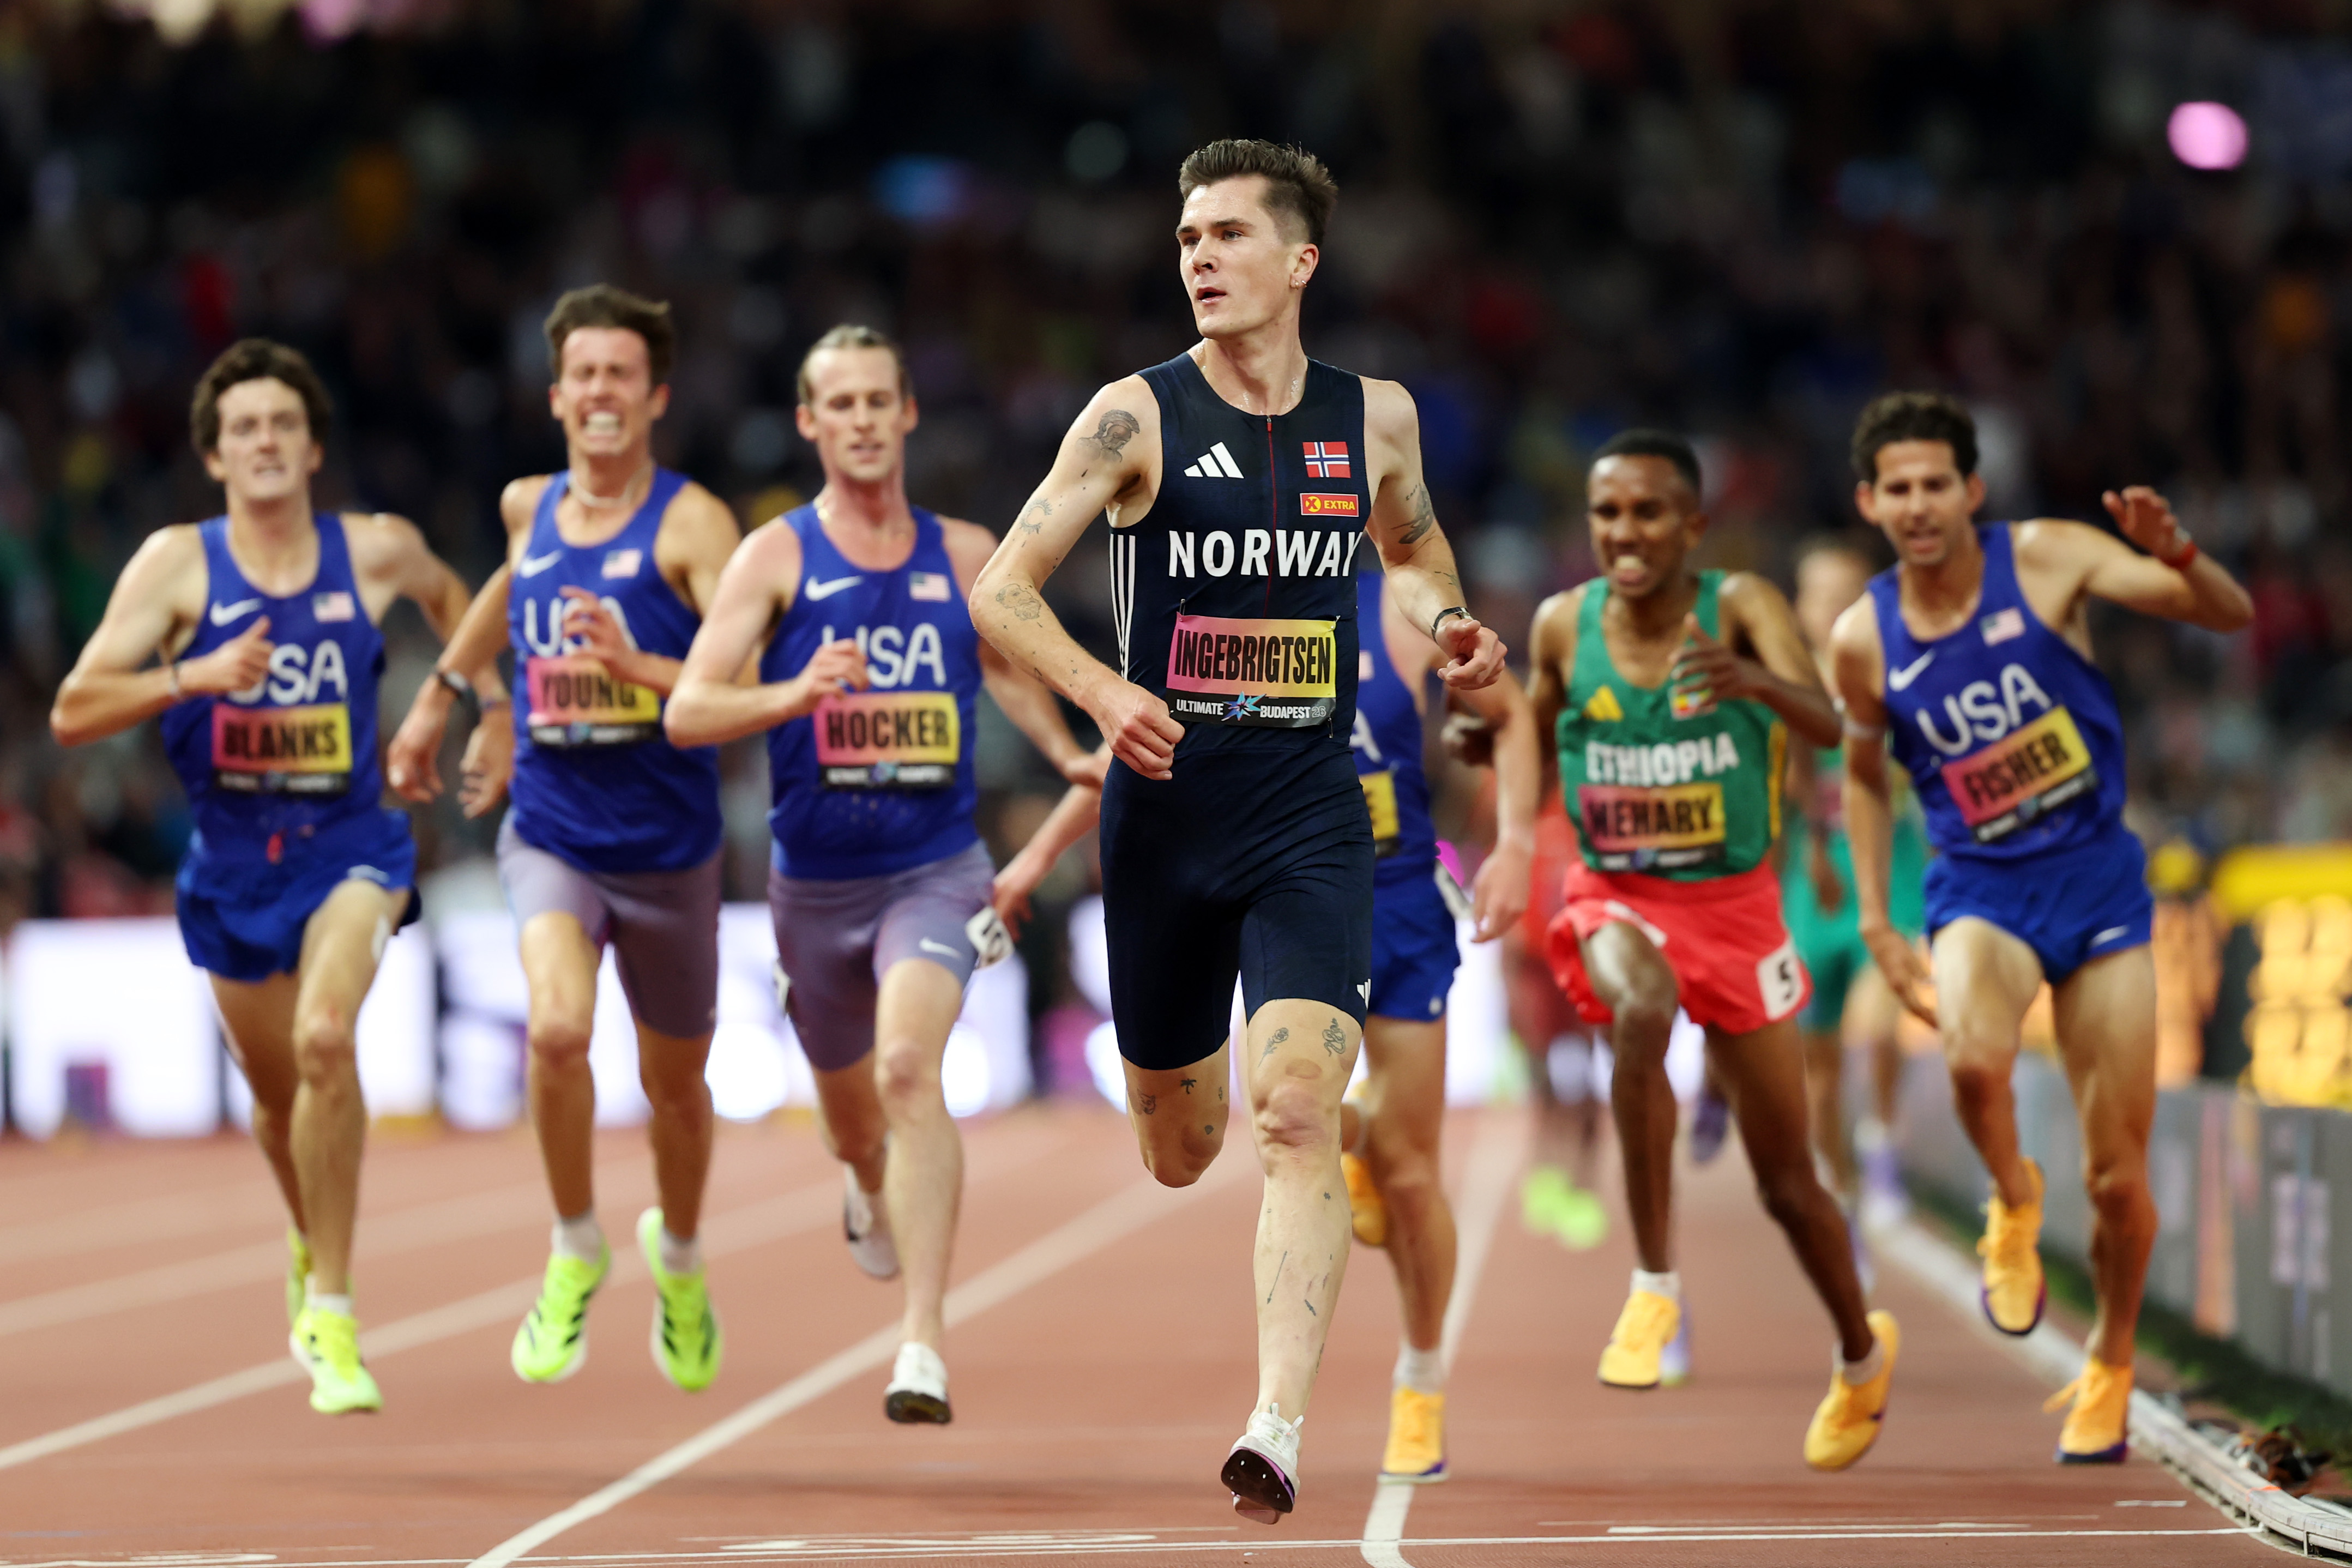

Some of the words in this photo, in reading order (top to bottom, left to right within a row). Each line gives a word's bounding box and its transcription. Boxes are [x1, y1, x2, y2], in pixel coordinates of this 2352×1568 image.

[1324, 500, 1356, 510] EXTRA
[1168, 529, 1362, 577] NORWAY
[1174, 629, 1331, 684] INGEBRIGTSEN
[540, 674, 636, 708] YOUNG
[1177, 699, 1224, 715] ULTIMATE
[1260, 705, 1311, 719] BUDAPEST
[1311, 705, 1326, 718] 26
[1916, 664, 2052, 755] USA
[224, 720, 337, 758] BLANKS
[827, 709, 949, 749] HOCKER
[1585, 731, 1740, 787] ETHIOPIA
[1963, 730, 2071, 809] FISHER
[1588, 795, 1713, 837] MEHARY
